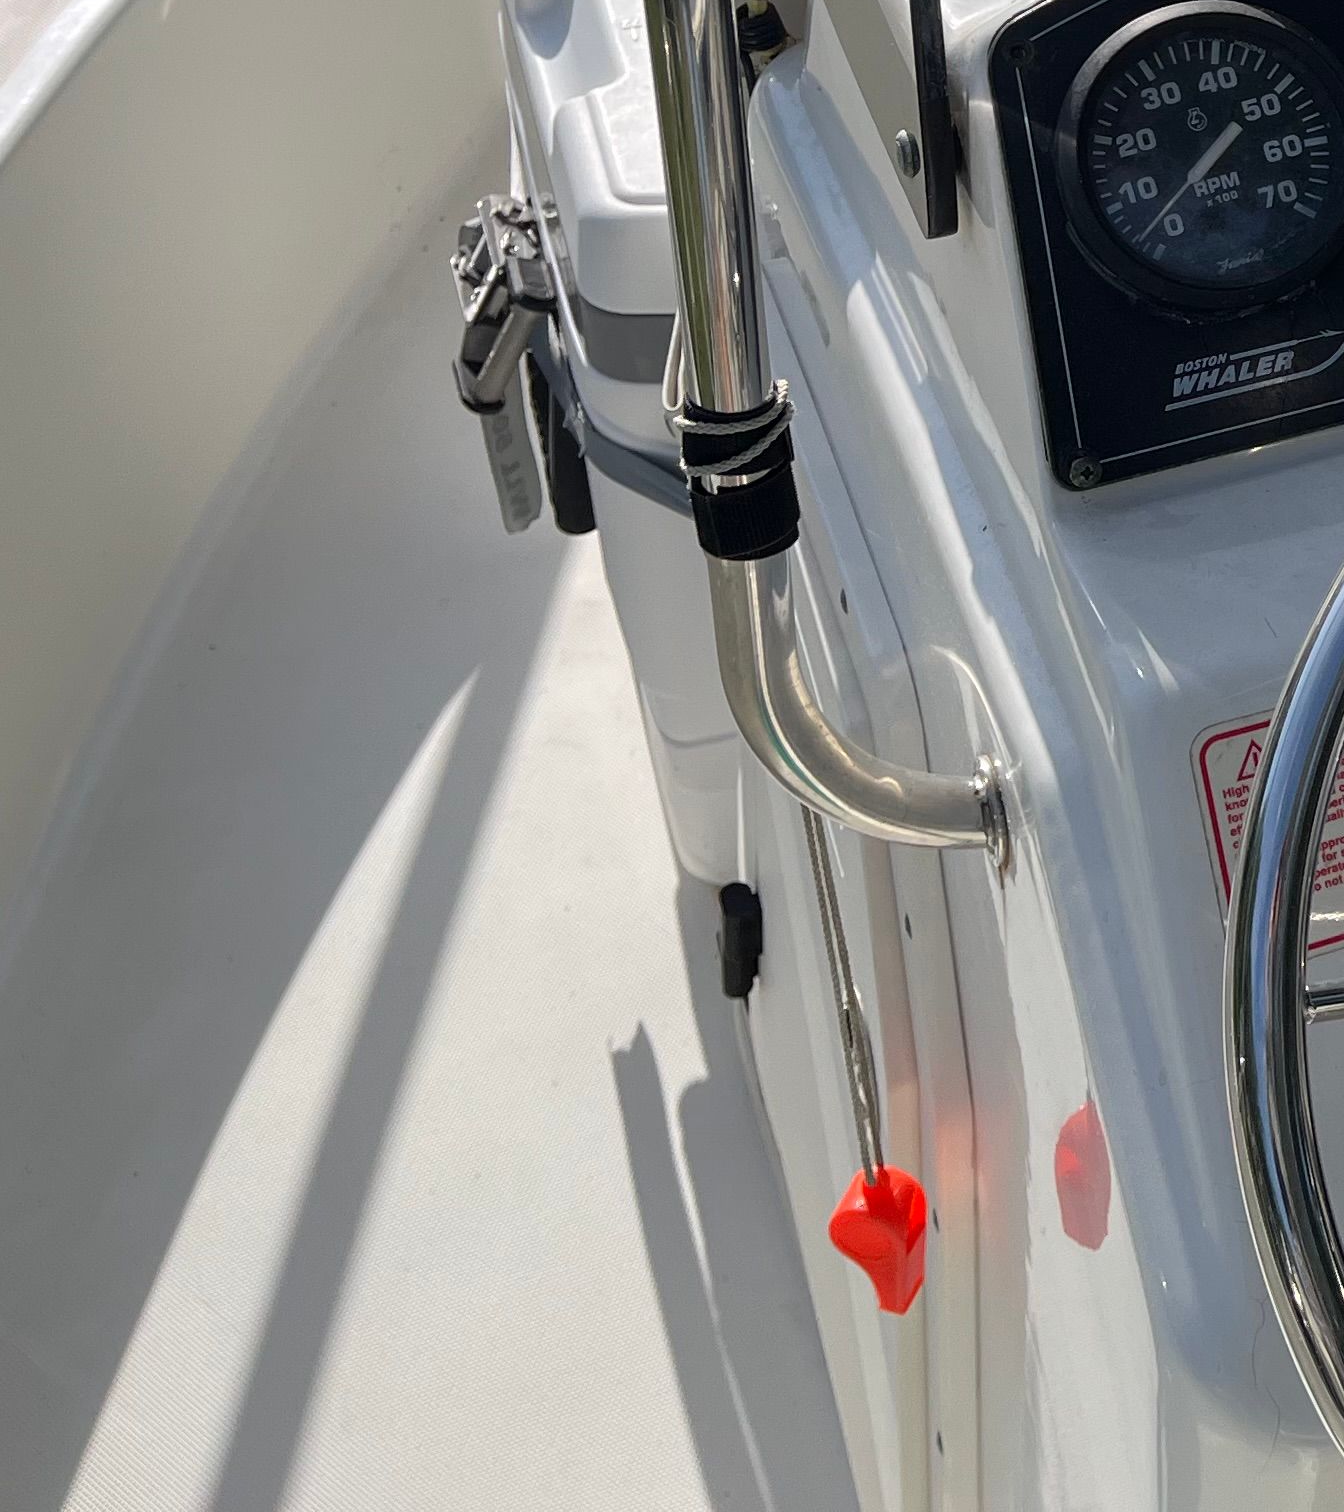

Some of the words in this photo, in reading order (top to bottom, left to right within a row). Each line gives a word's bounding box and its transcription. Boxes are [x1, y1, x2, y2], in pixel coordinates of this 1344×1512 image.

[1198, 66, 1239, 93] 40
[1140, 81, 1182, 111] 30
[1241, 92, 1281, 122] 50
[1115, 127, 1157, 158] 20
[1263, 134, 1303, 163] 60
[1118, 175, 1159, 204] 10
[1193, 171, 1241, 198] RPM
[1257, 179, 1298, 209] 70
[1163, 212, 1185, 238] 0
[1172, 350, 1295, 398] WHALER
[1175, 352, 1228, 375] BOSTON
[1222, 784, 1250, 799] High
[1225, 798, 1249, 811] kno
[1321, 851, 1338, 863] for
[1324, 873, 1344, 888] not
